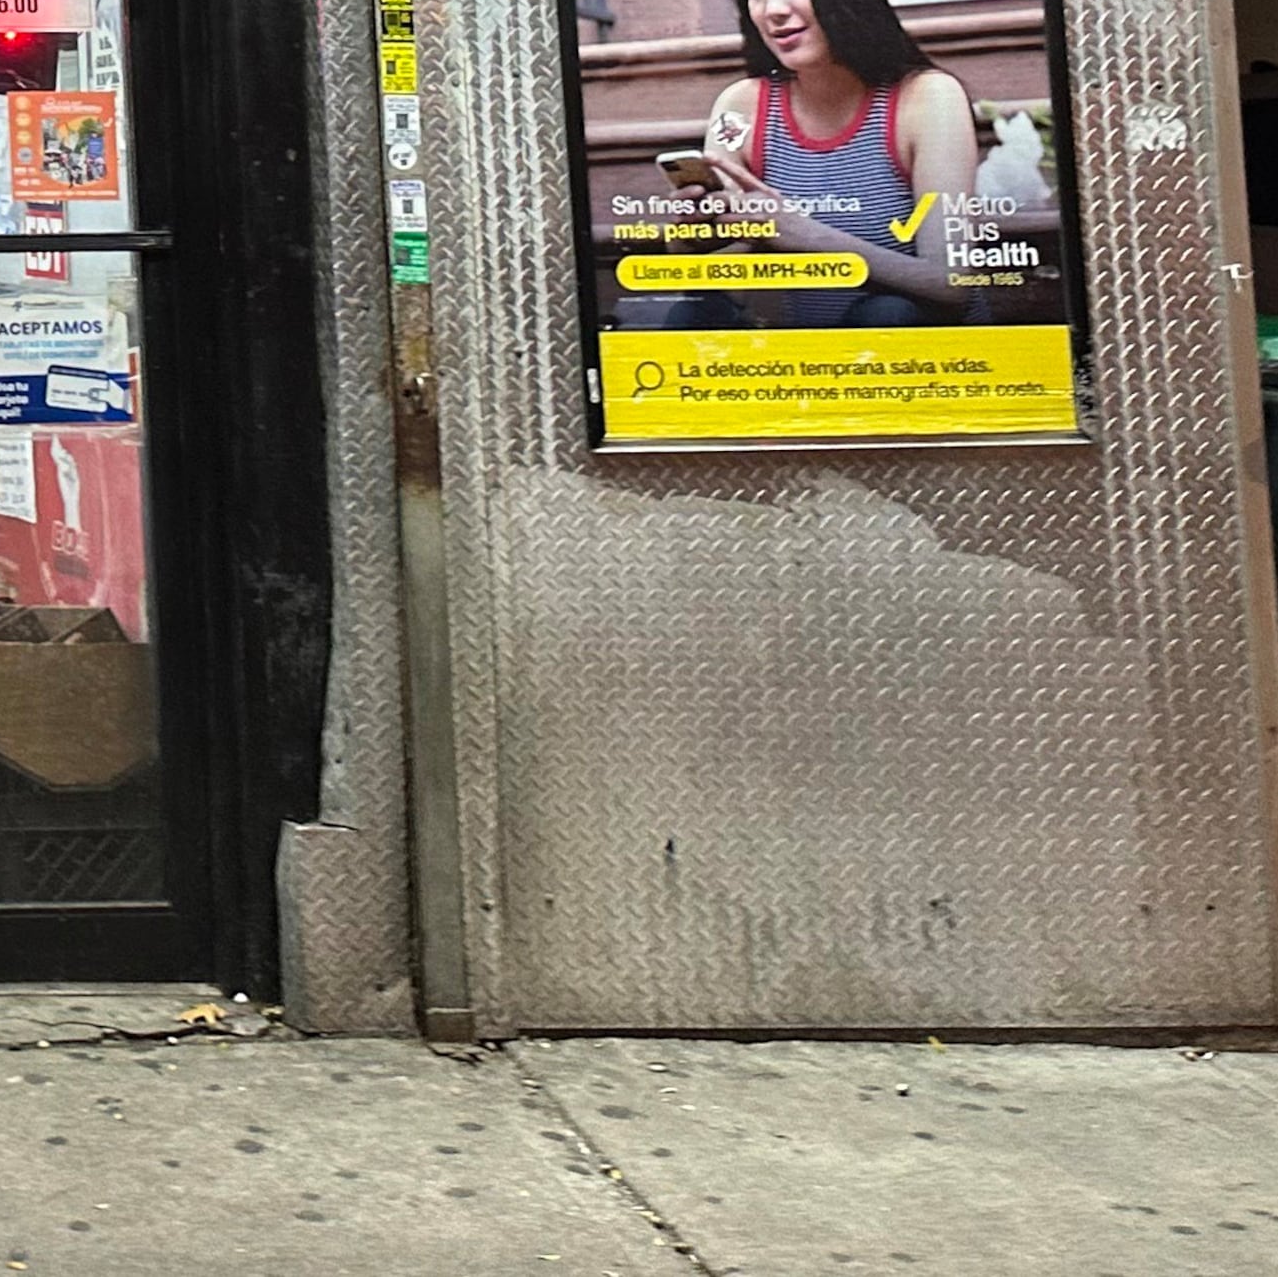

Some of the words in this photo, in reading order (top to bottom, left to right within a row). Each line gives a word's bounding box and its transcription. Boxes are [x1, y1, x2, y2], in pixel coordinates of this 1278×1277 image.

[611, 195, 644, 215] Sin
[648, 195, 696, 215] fines
[699, 196, 727, 215] de
[730, 195, 778, 214] lucro
[782, 195, 862, 218] significa
[941, 192, 1018, 217] Metro
[613, 220, 659, 241] más
[663, 222, 713, 243] para
[716, 219, 782, 238] usted.
[944, 216, 1001, 243] Plus
[946, 241, 1041, 268] Health
[633, 264, 684, 281] Llame
[687, 263, 702, 280] al
[707, 263, 749, 280] (833)
[678, 362, 703, 379] La
[706, 360, 794, 379] detección
[800, 360, 885, 380] temprana
[890, 359, 937, 375] salva
[940, 358, 994, 375] vidas.
[680, 385, 709, 402] Por
[716, 387, 750, 402] eso
[755, 383, 839, 402] cubrimos
[965, 382, 991, 398] sin
